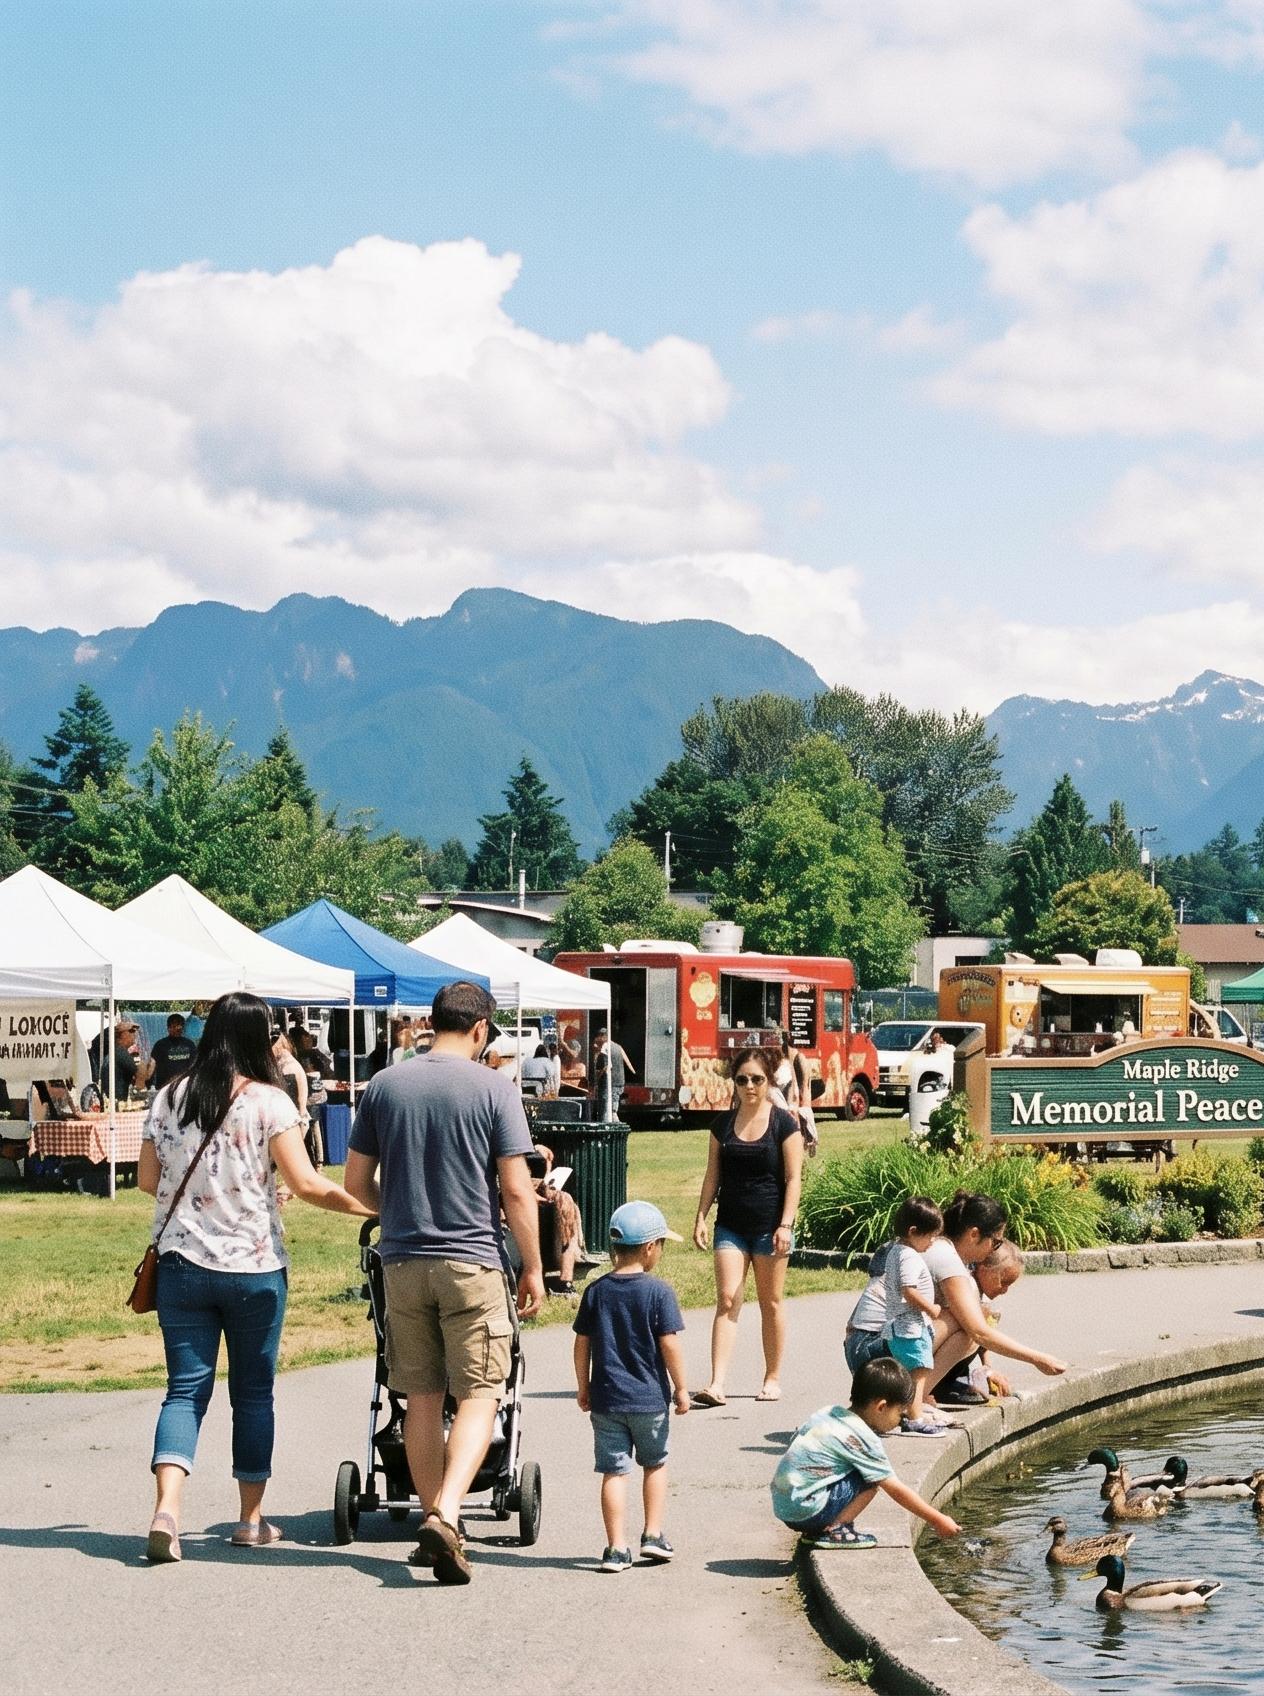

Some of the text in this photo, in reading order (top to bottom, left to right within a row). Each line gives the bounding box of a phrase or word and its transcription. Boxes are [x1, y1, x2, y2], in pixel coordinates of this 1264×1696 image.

[1122, 1058, 1239, 1084] Maple Ridge
[1010, 1090, 1166, 1126] Memorial
[1176, 1089, 1264, 1122] Peace
